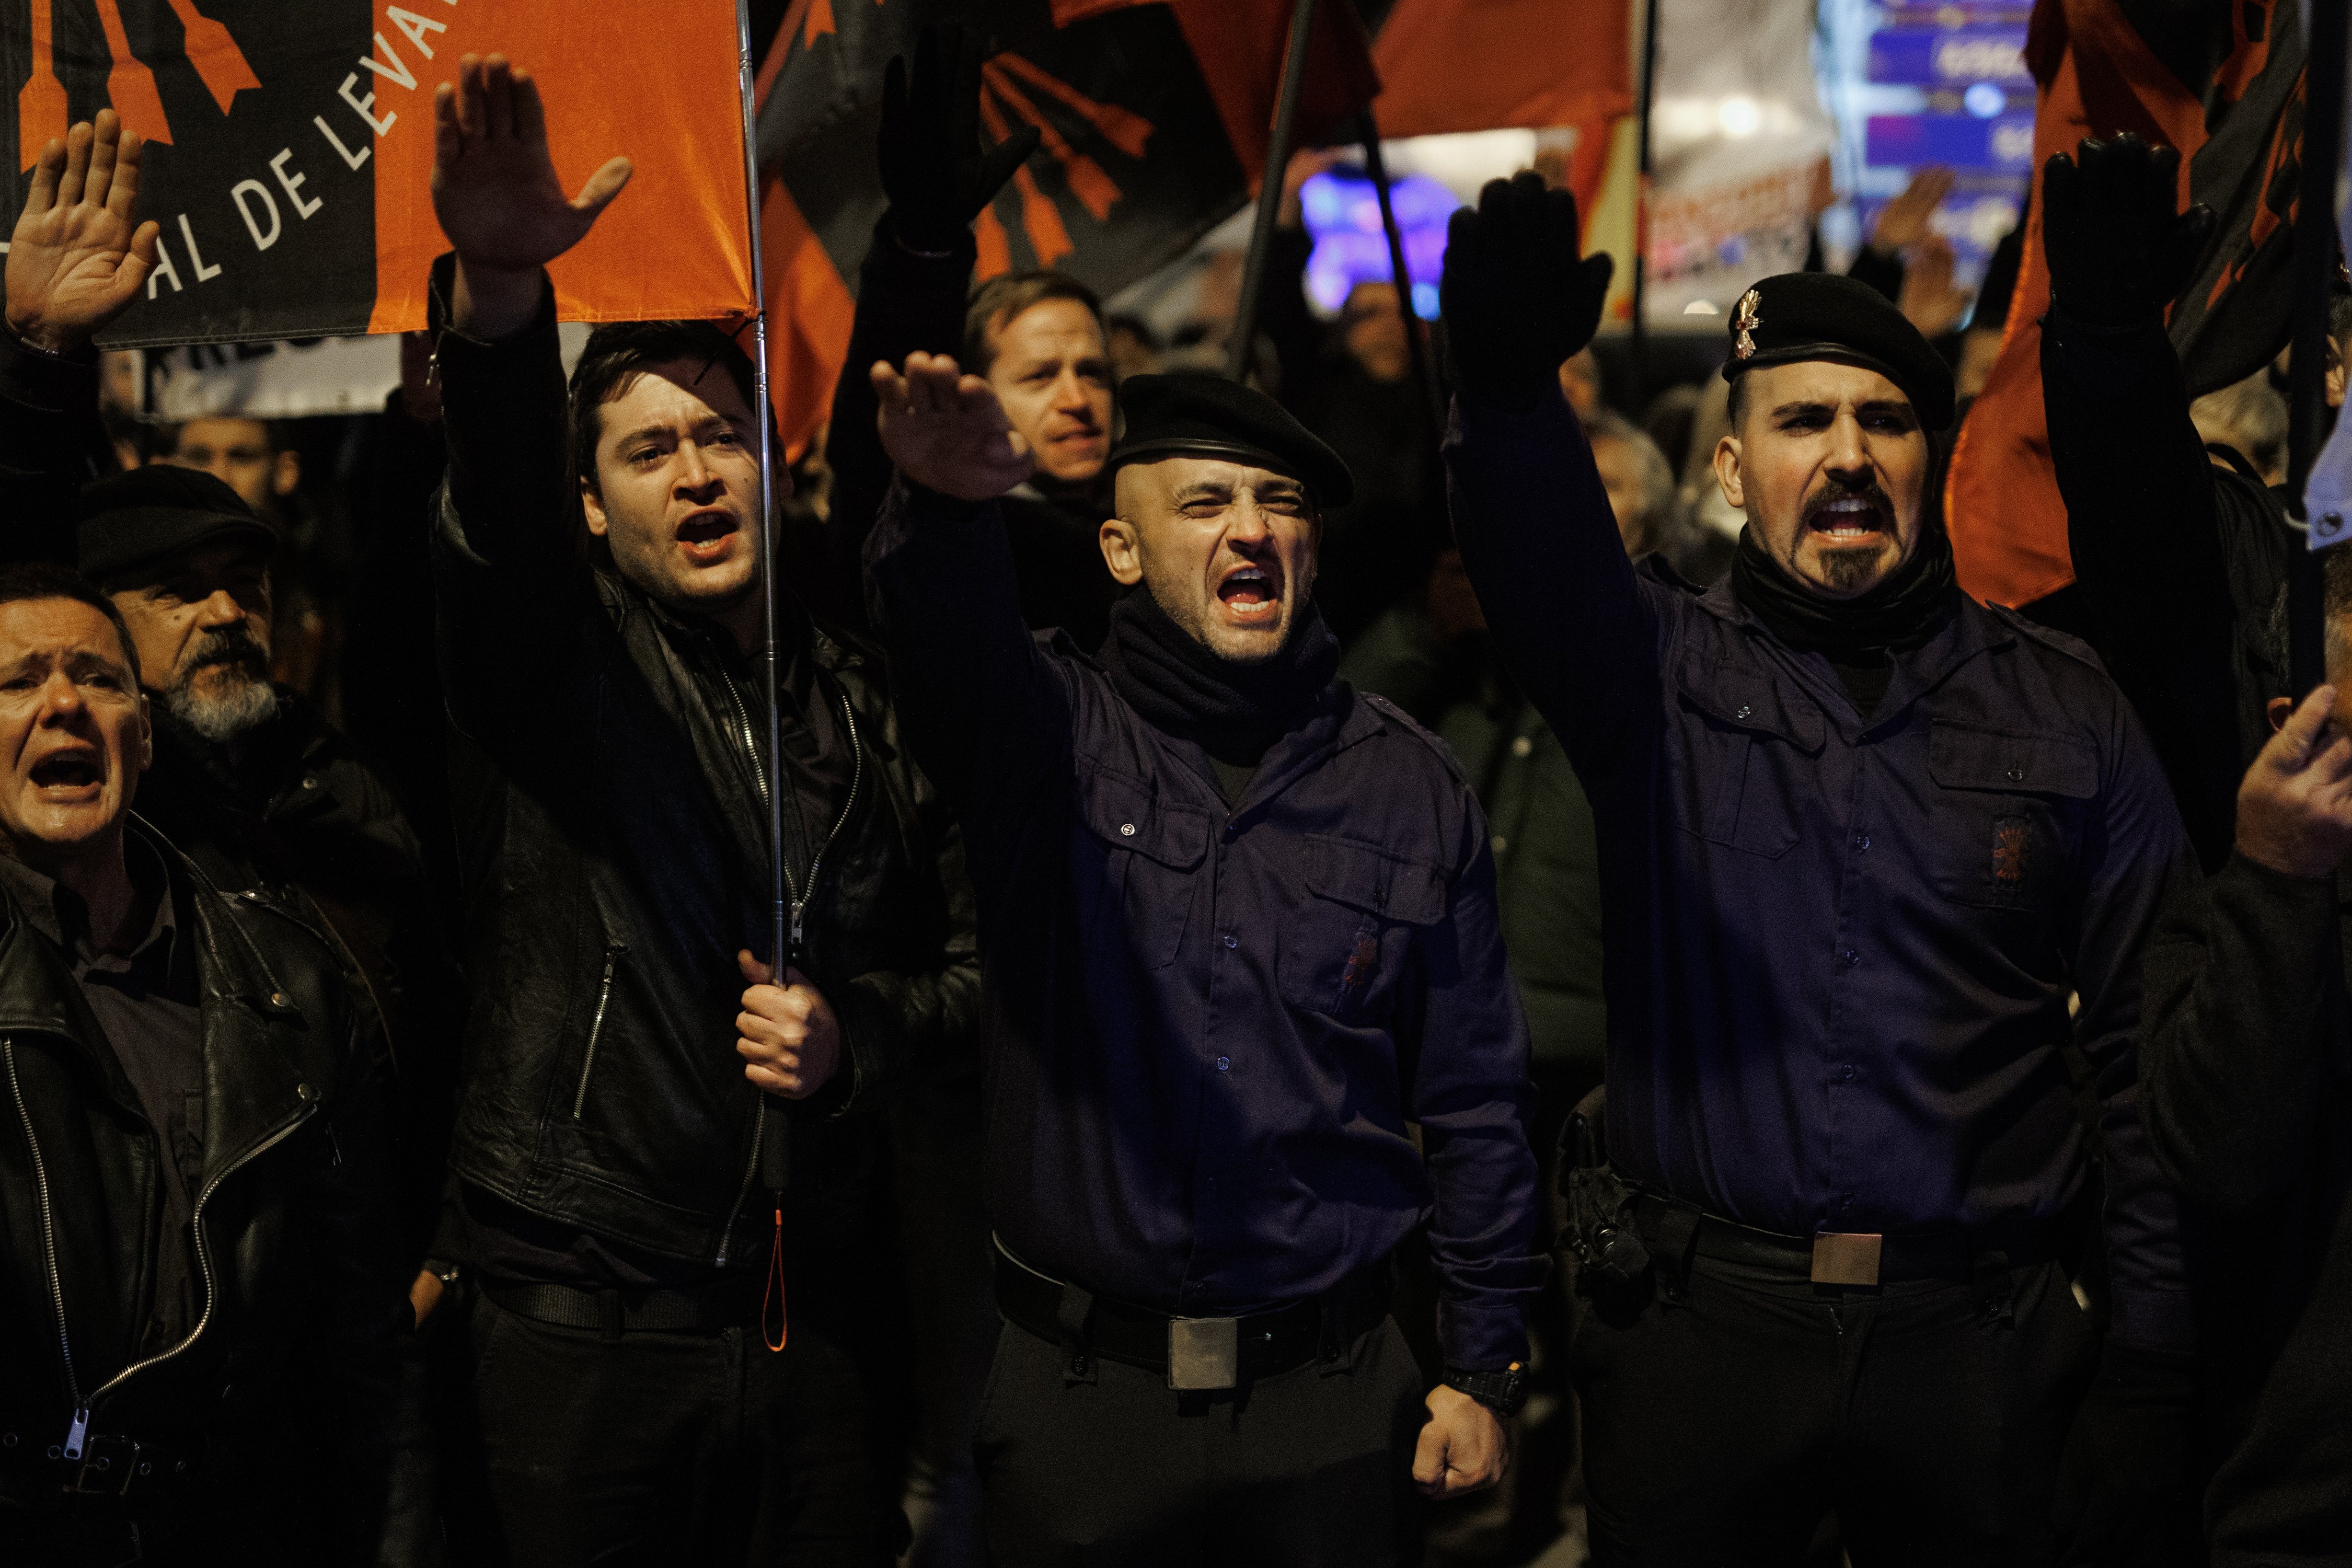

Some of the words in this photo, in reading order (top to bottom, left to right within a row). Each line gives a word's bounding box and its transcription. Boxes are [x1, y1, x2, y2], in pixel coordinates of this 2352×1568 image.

[148, 213, 222, 300] AL
[230, 147, 323, 251] DE
[314, 0, 458, 171] LEVA
